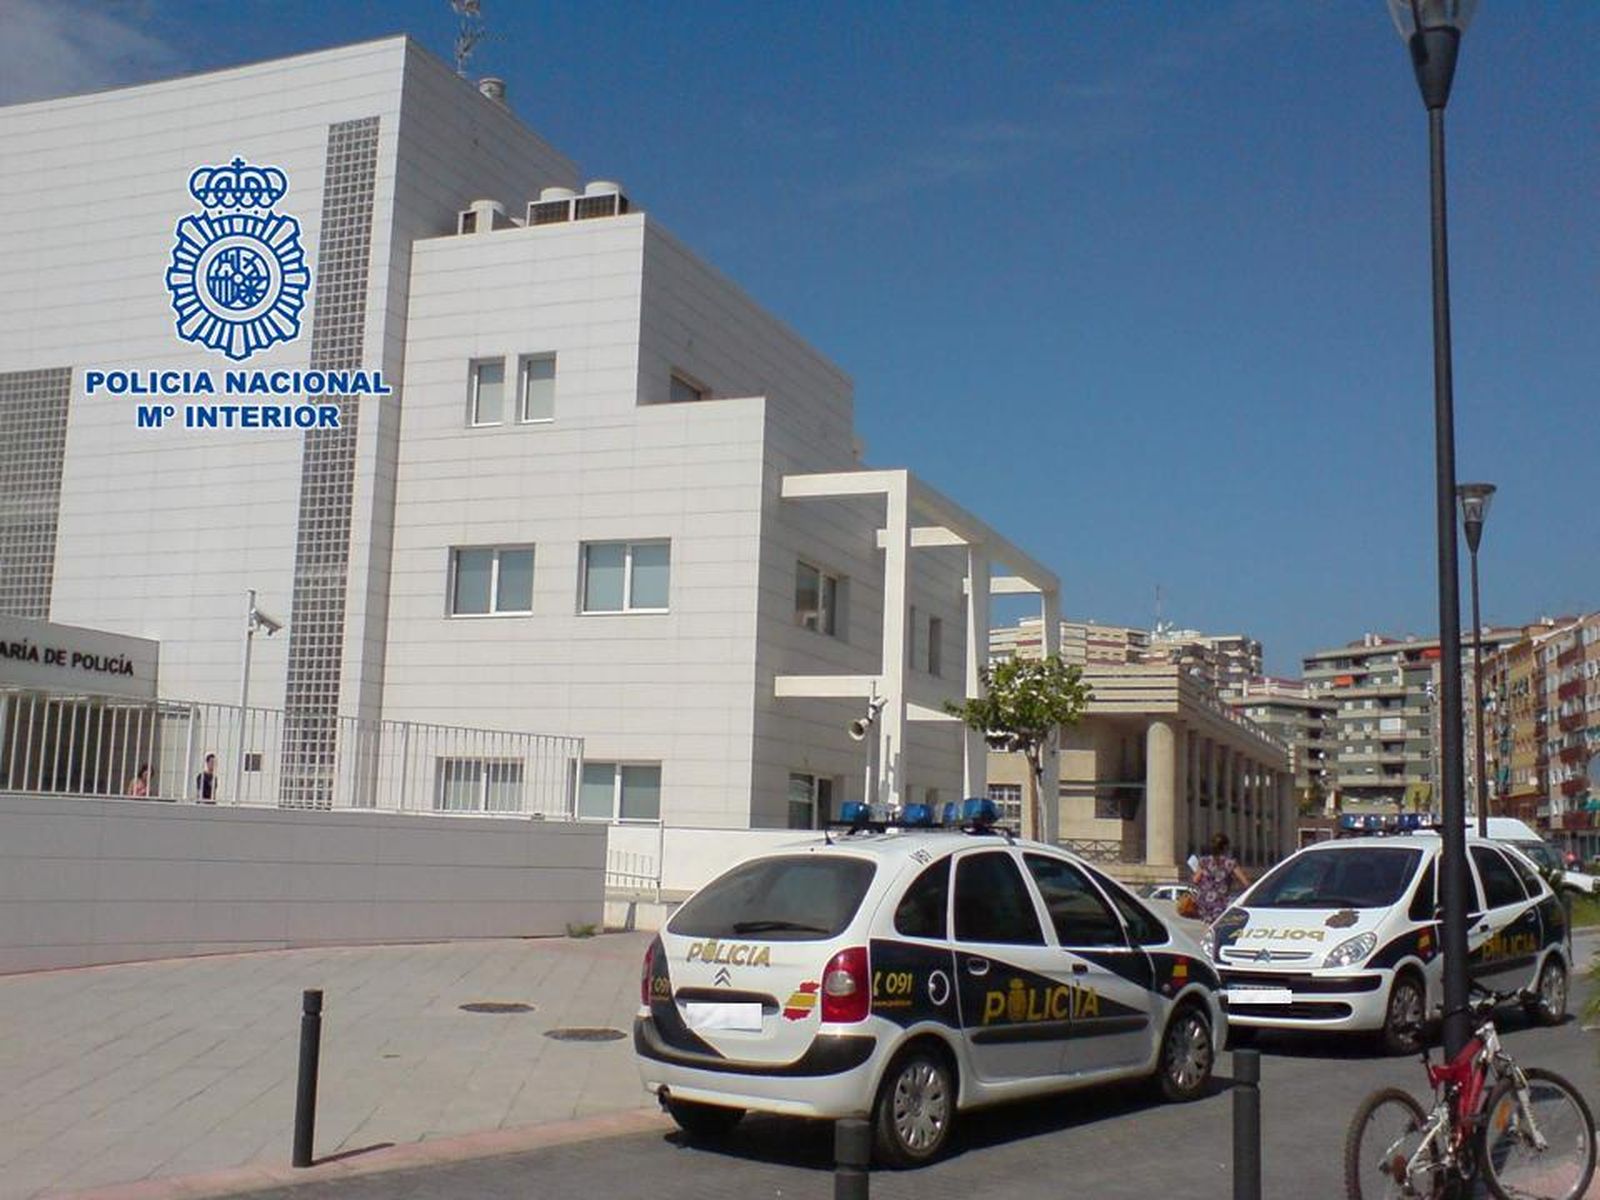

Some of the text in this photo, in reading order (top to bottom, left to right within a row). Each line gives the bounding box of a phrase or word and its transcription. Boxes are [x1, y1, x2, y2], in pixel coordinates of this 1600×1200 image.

[43, 647, 67, 668] DE
[71, 652, 134, 676] POLICÍA
[685, 941, 771, 967] POLICIA
[886, 972, 913, 994] 091
[983, 979, 1099, 1025] POLICIA
